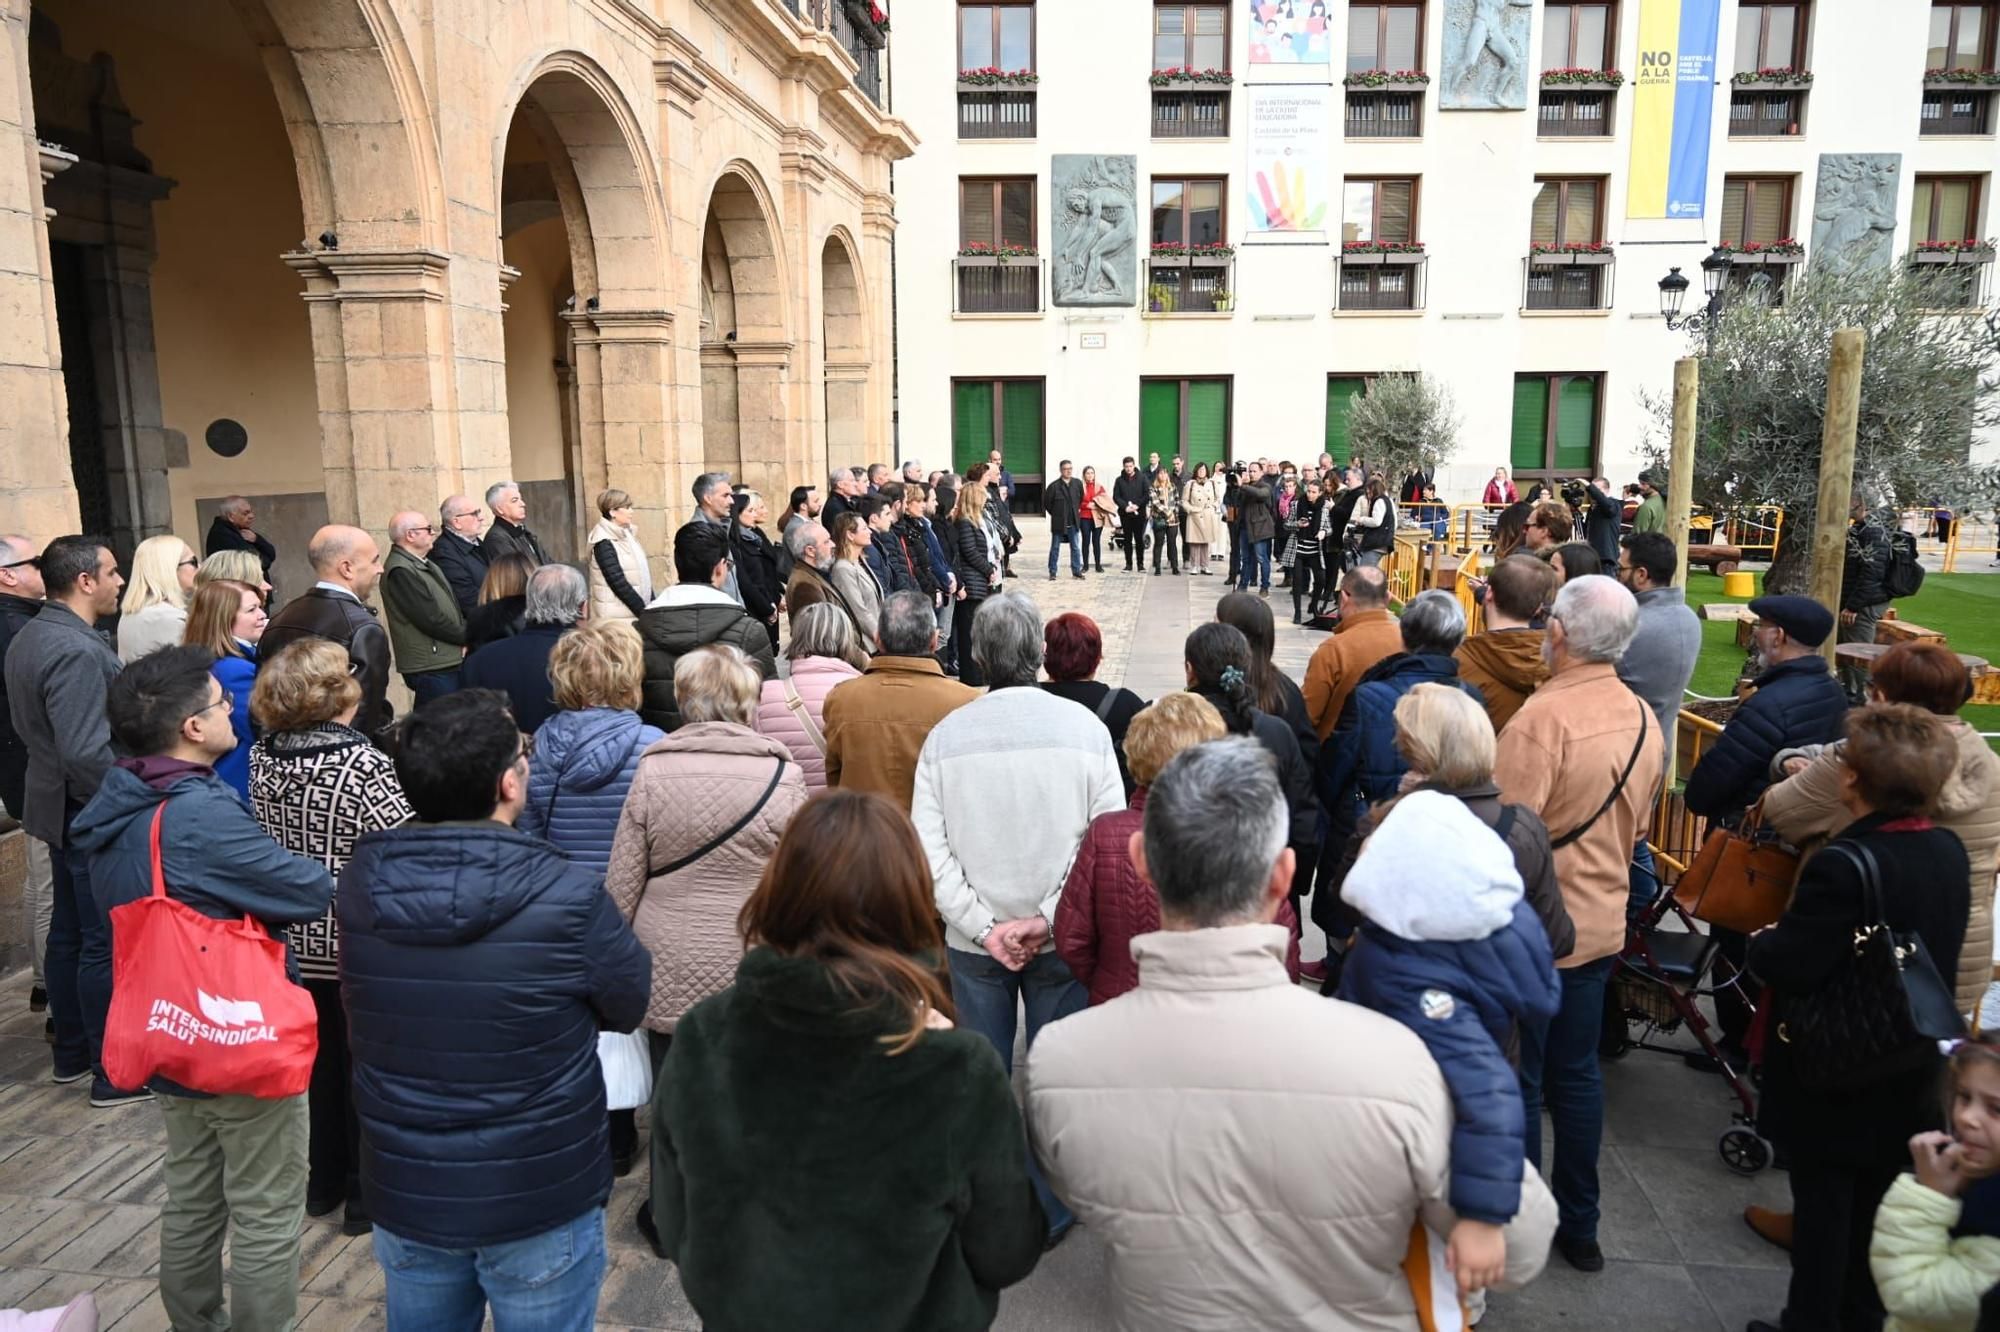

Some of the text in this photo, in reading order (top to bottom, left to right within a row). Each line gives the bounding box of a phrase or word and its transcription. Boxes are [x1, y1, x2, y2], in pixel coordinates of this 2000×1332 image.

[1641, 51, 1671, 66] NO
[1641, 67, 1670, 77] A LA
[1269, 98, 1321, 106] INTERNACIONAL
[151, 999, 278, 1046] INTERSINDICAL
[146, 1016, 197, 1045] SALUT
